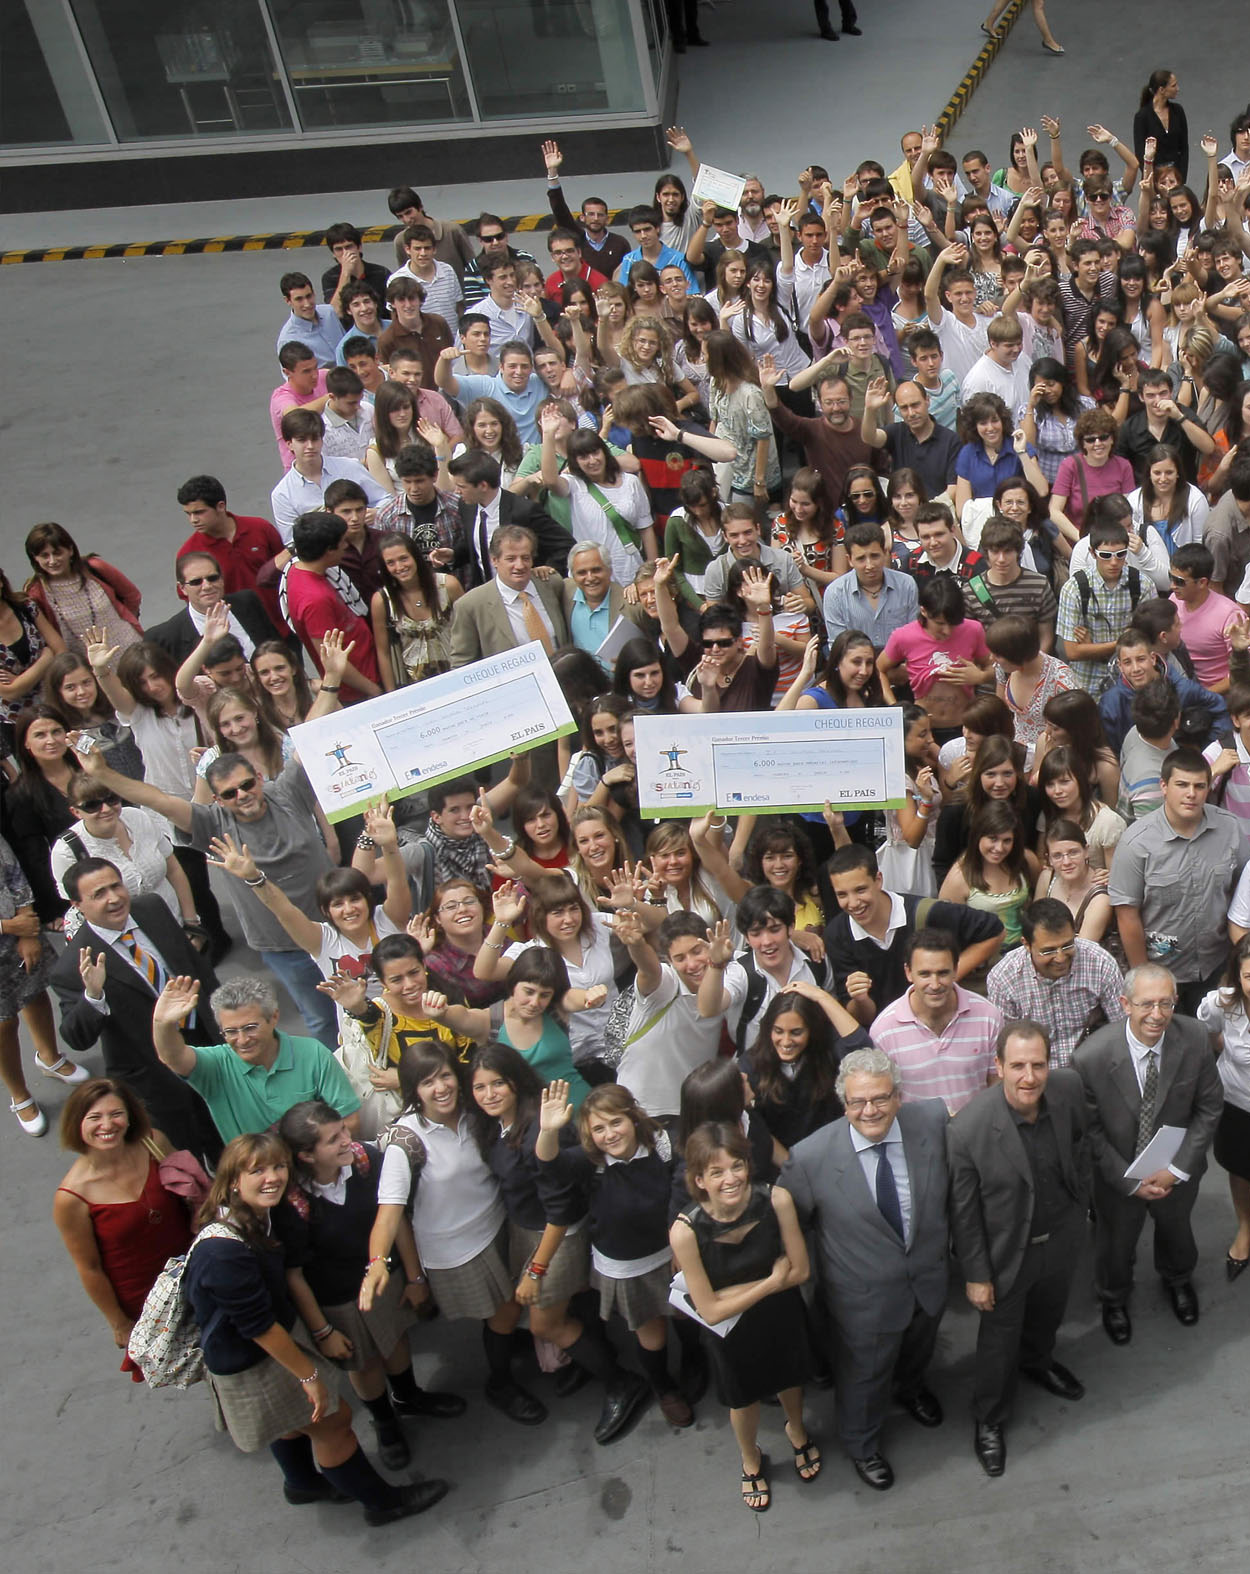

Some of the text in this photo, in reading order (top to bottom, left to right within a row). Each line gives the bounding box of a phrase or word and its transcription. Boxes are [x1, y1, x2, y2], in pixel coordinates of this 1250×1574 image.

[463, 652, 537, 685] CHEQUE REGALO
[814, 717, 893, 729] CHEQUE REGALO
[510, 731, 525, 742] EL
[421, 760, 448, 776] endesa
[753, 759, 776, 767] 6.000
[743, 792, 770, 802] endesa
[839, 790, 853, 798] EL
